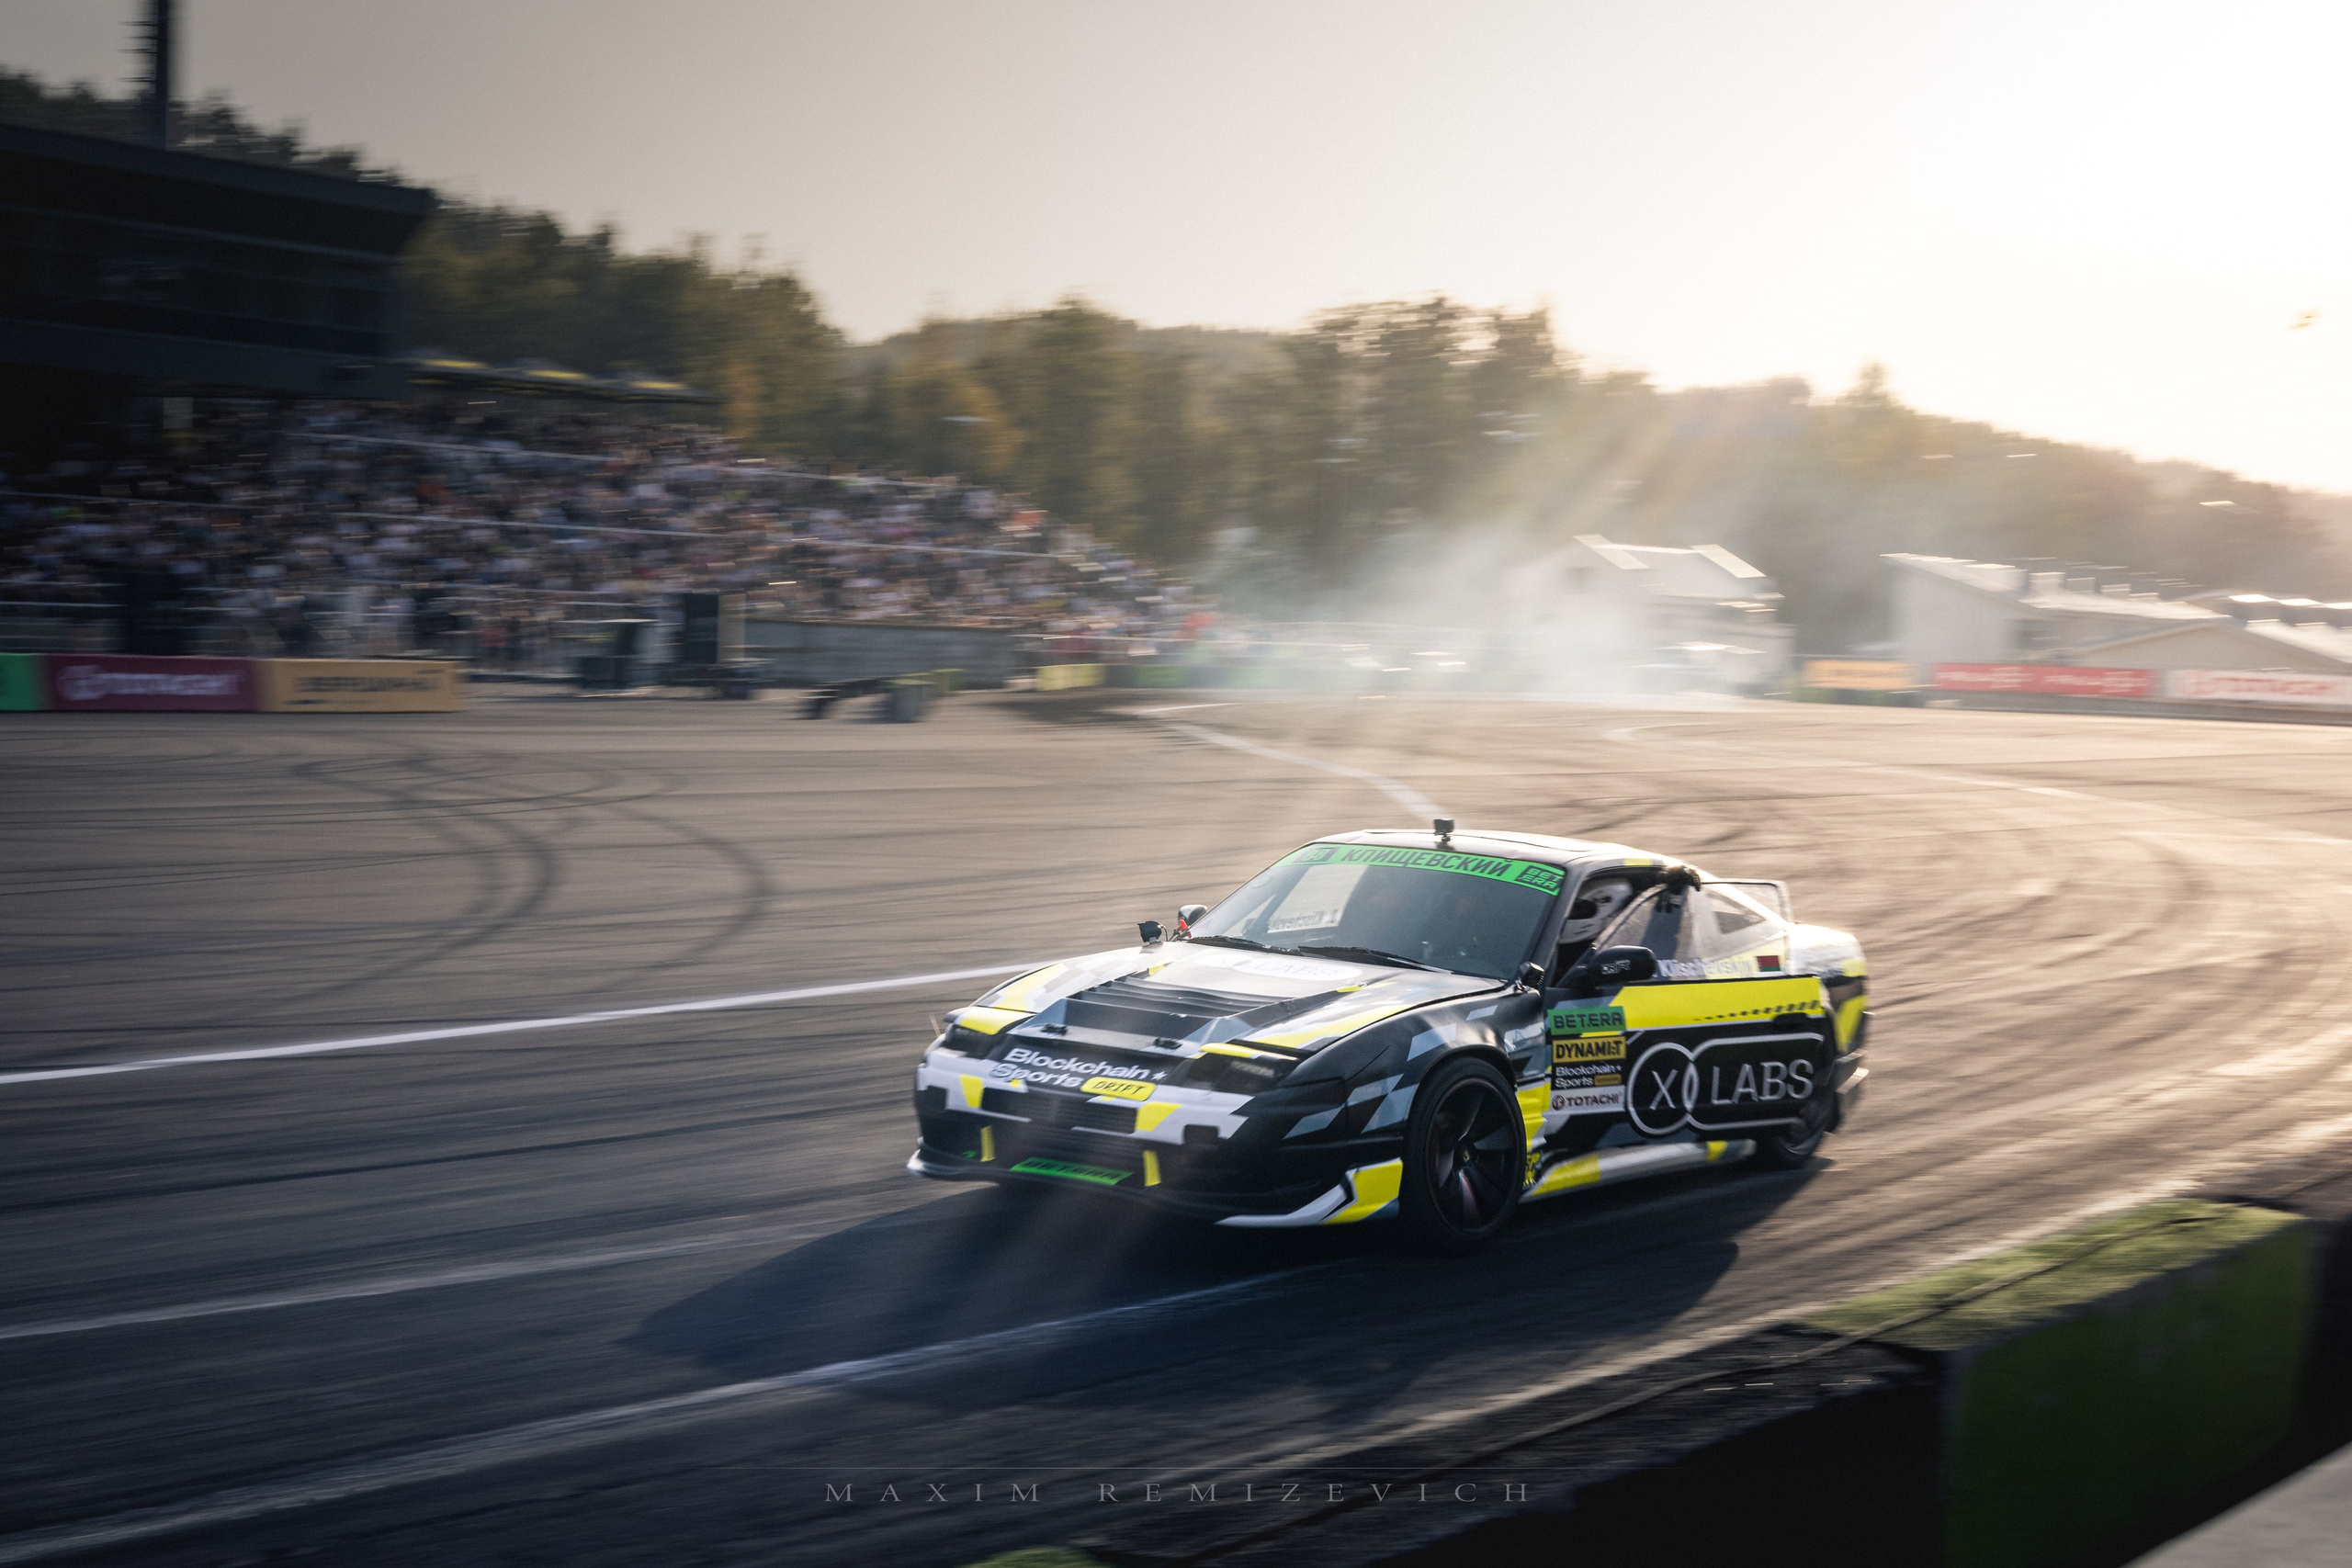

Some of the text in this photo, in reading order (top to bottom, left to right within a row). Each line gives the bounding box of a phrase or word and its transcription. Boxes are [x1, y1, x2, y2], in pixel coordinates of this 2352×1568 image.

[1340, 848, 1511, 876] КЛИЩЕВСКИЙ
[1526, 868, 1564, 881] BET
[1003, 1047, 1151, 1080] Blockchain
[1555, 1064, 1616, 1077] Blockchain
[989, 1062, 1145, 1095] Sports DRIFT
[1555, 1076, 1593, 1089] Sports
[1711, 1058, 1814, 1105] LABS
[1566, 1093, 1620, 1107] TOTACHI
